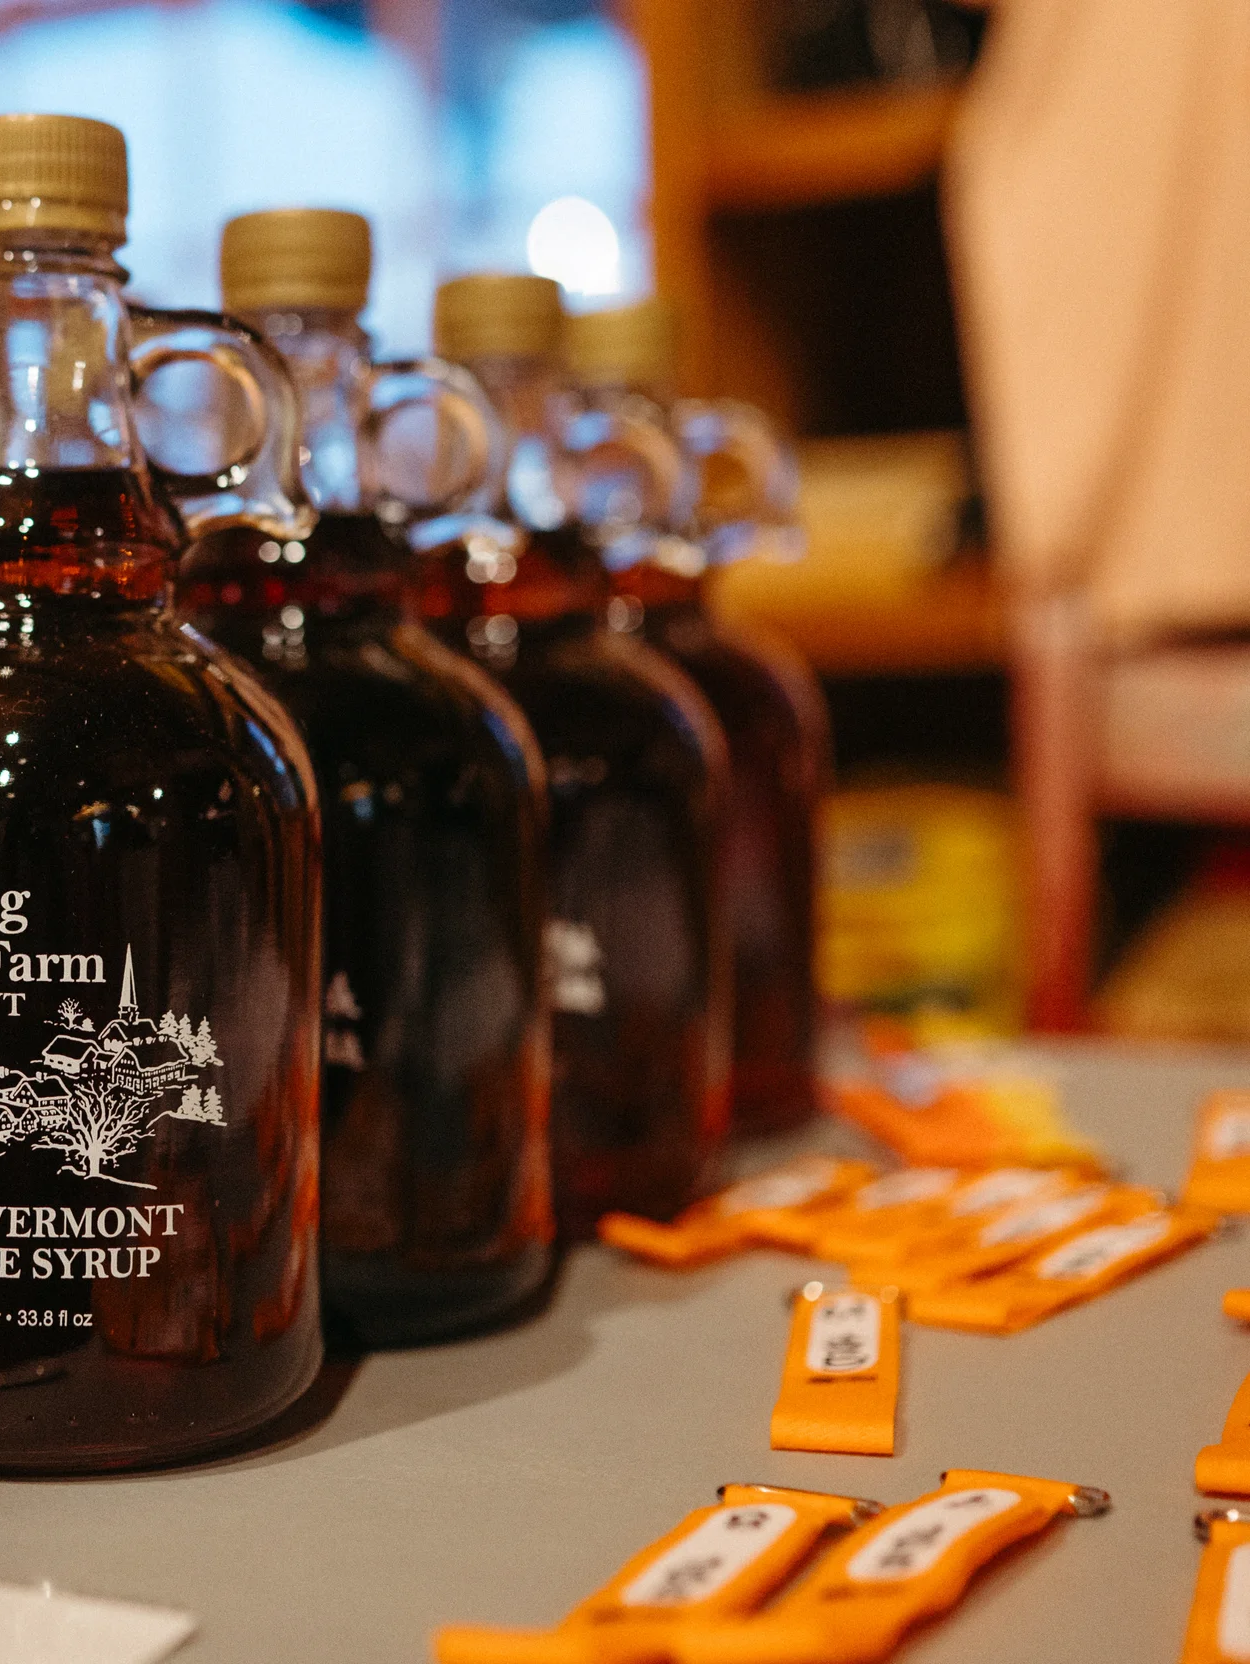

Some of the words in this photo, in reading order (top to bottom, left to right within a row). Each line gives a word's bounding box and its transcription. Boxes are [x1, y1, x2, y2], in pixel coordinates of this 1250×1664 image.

[31, 1246, 162, 1280] SYRUP
[17, 1309, 54, 1327] 33.8
[58, 1309, 68, 1327] fl
[73, 1313, 94, 1327] oz
